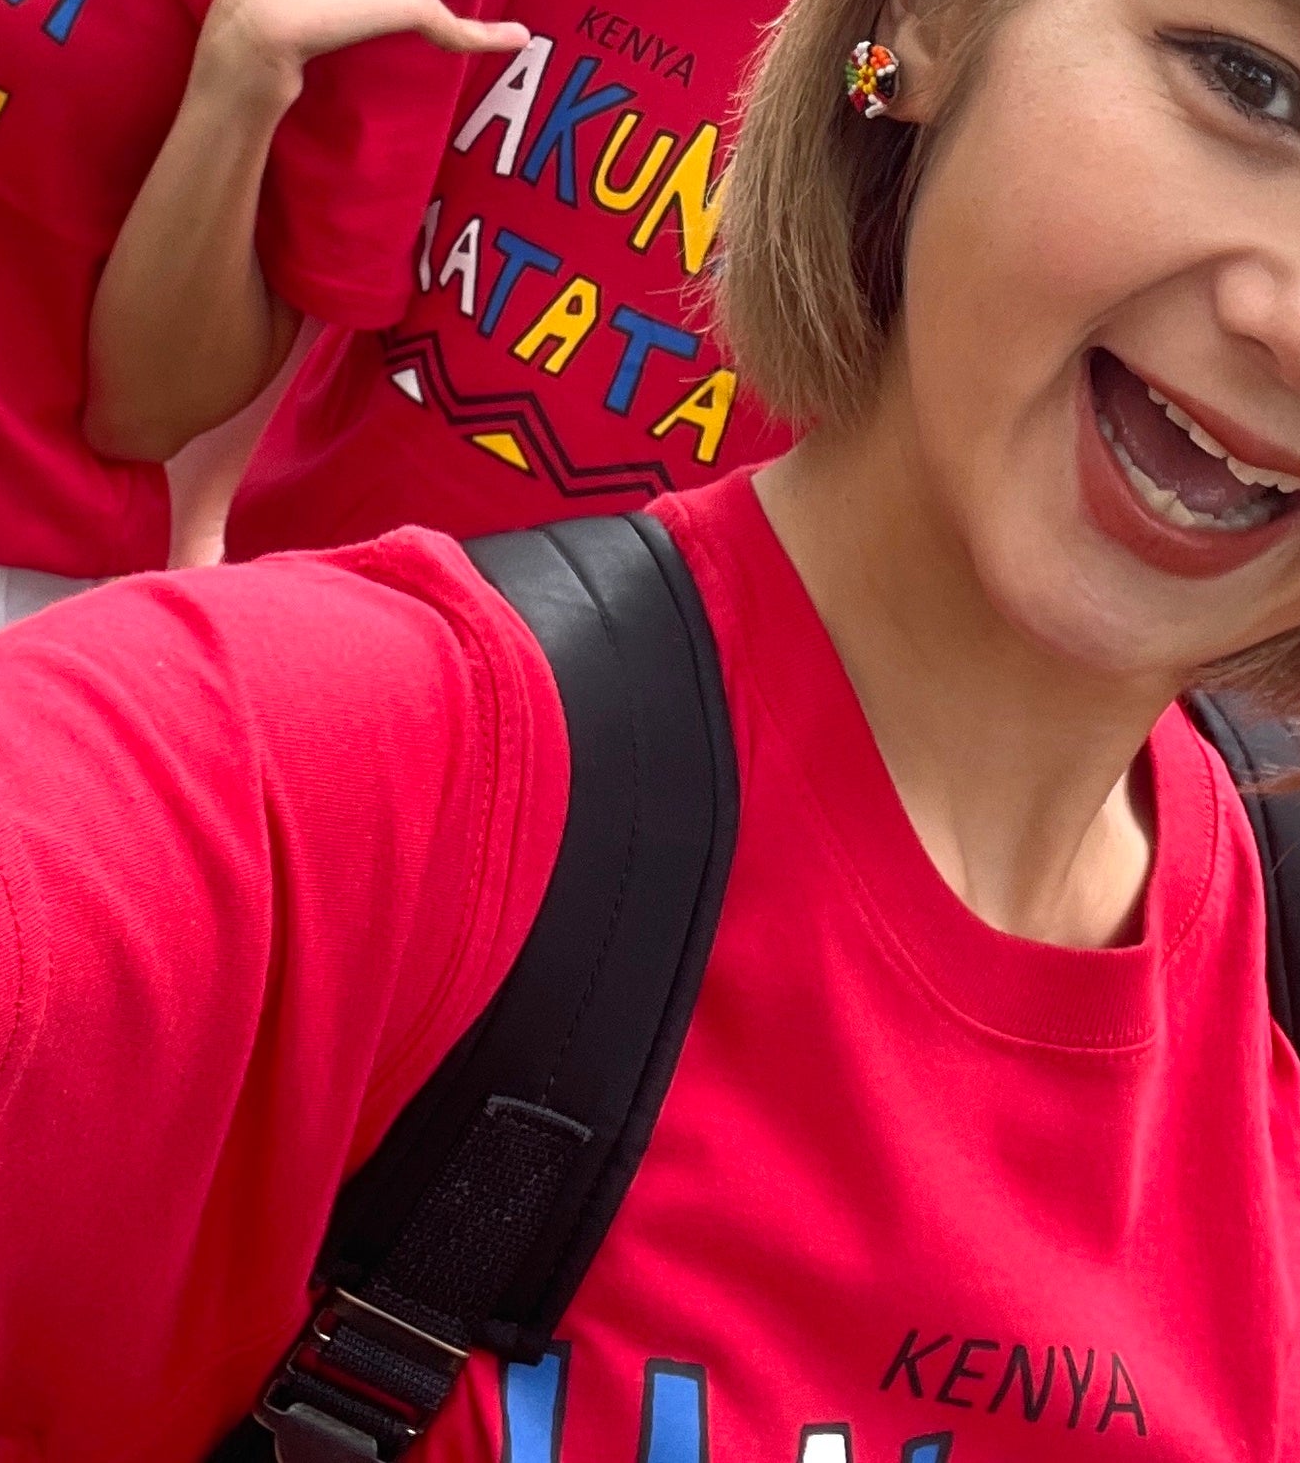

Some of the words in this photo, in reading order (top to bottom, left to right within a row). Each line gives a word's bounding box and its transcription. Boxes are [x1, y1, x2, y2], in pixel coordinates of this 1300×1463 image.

[576, 4, 698, 88] KENYA
[413, 198, 738, 466] ATATA
[879, 1329, 1148, 1437] KENYA
